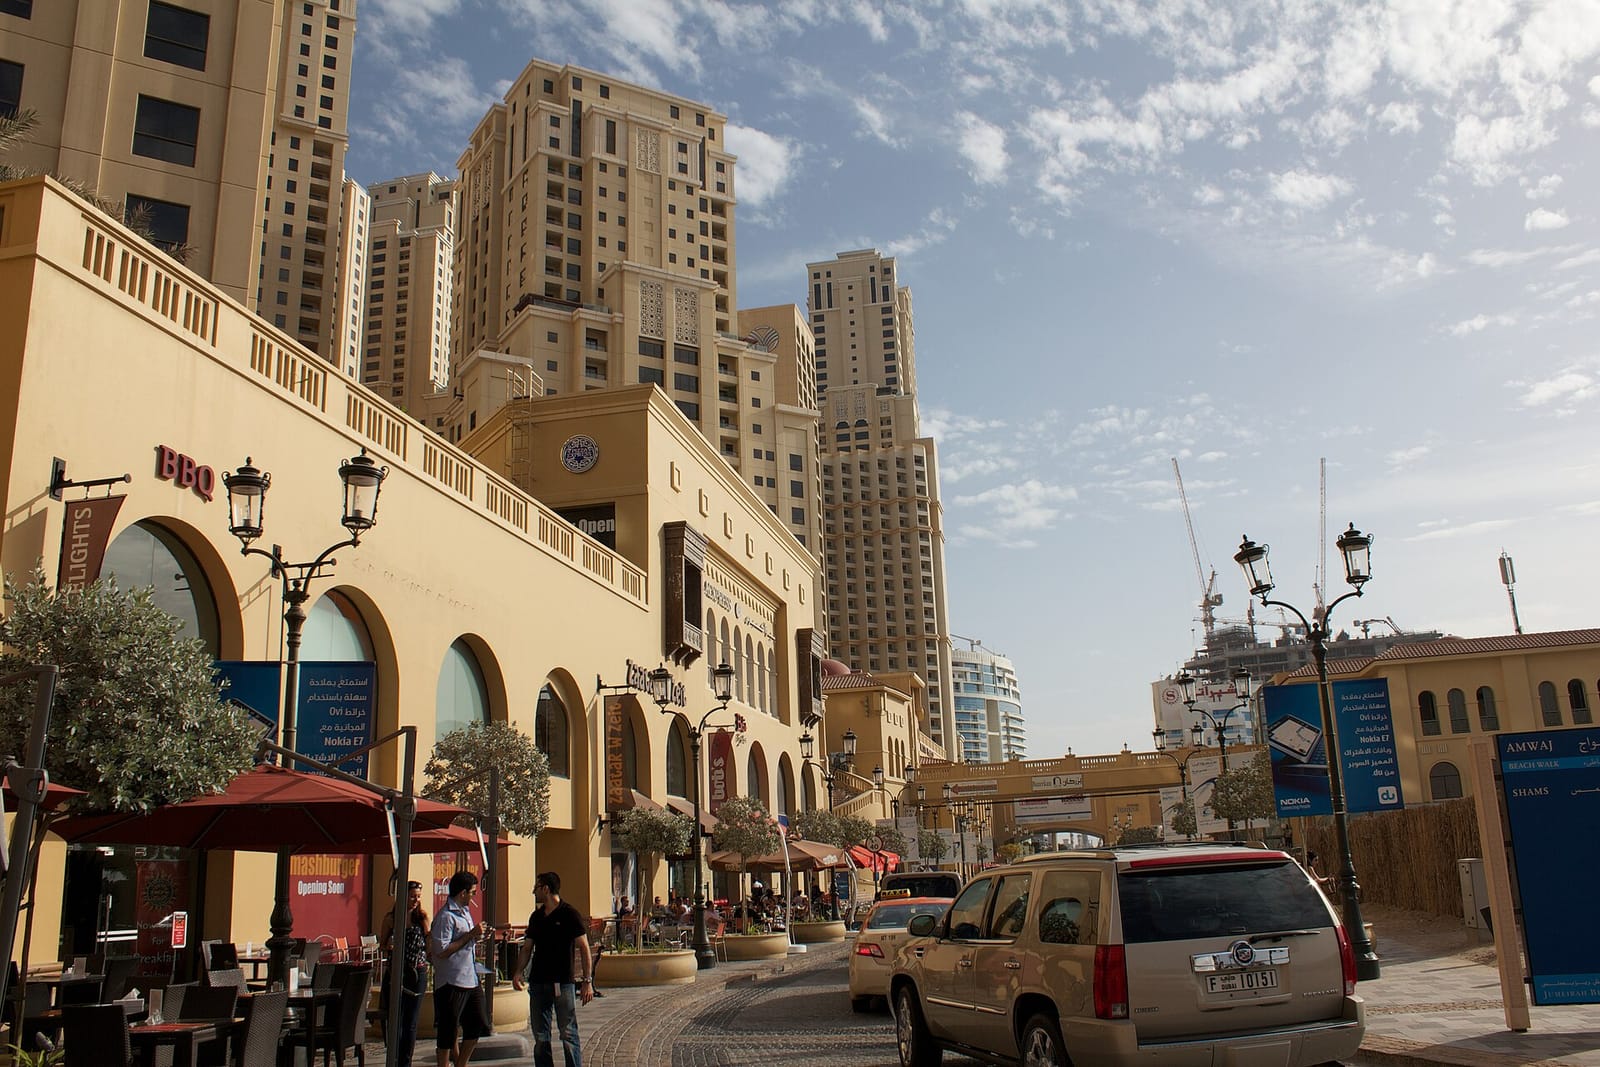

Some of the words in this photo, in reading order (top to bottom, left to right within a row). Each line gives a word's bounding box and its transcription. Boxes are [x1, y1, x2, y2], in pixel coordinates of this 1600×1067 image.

[157, 444, 215, 502] BBQ
[579, 518, 615, 536] Open
[69, 507, 92, 595] ELIGHTS
[329, 706, 343, 716] Ovi
[324, 736, 351, 746] Nokia
[353, 736, 364, 746] E7
[1360, 735, 1380, 743] Nokia
[1381, 734, 1390, 742] E7
[1578, 736, 1600, 753] واج
[1506, 740, 1553, 753] AMWAJ
[1509, 761, 1535, 770] BEACH
[1536, 760, 1560, 768] WALK
[1381, 790, 1395, 801] du
[1512, 786, 1549, 797] SHAMS
[1280, 797, 1310, 806] NOKIA
[290, 855, 360, 879] mashburger
[298, 880, 328, 897] Opening
[328, 880, 345, 895] Soon
[1209, 977, 1217, 991] F
[1240, 971, 1274, 988] 10151
